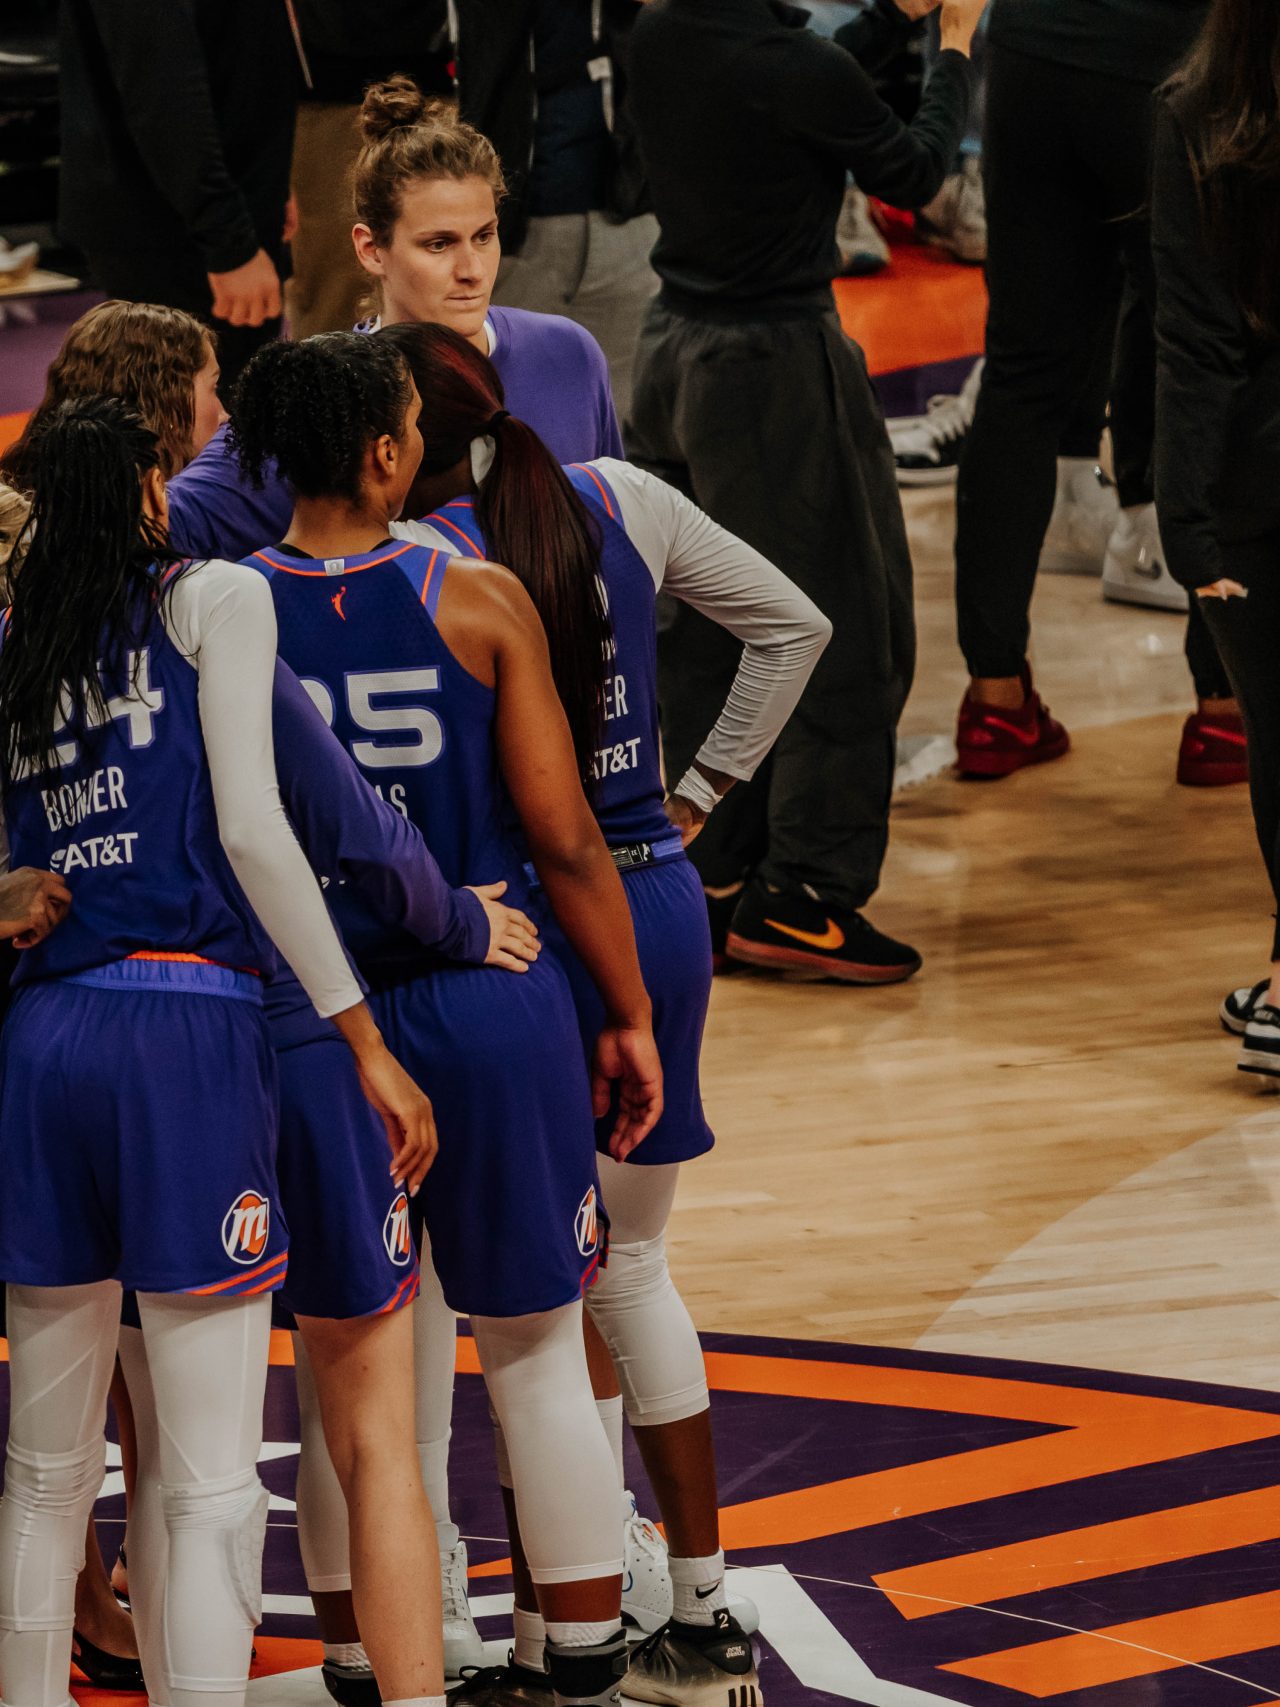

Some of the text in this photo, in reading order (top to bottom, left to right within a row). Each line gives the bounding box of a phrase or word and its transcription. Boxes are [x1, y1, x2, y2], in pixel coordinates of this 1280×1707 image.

[297, 664, 446, 769] 5
[63, 832, 139, 874] AT&T
[719, 1613, 729, 1628] 2
